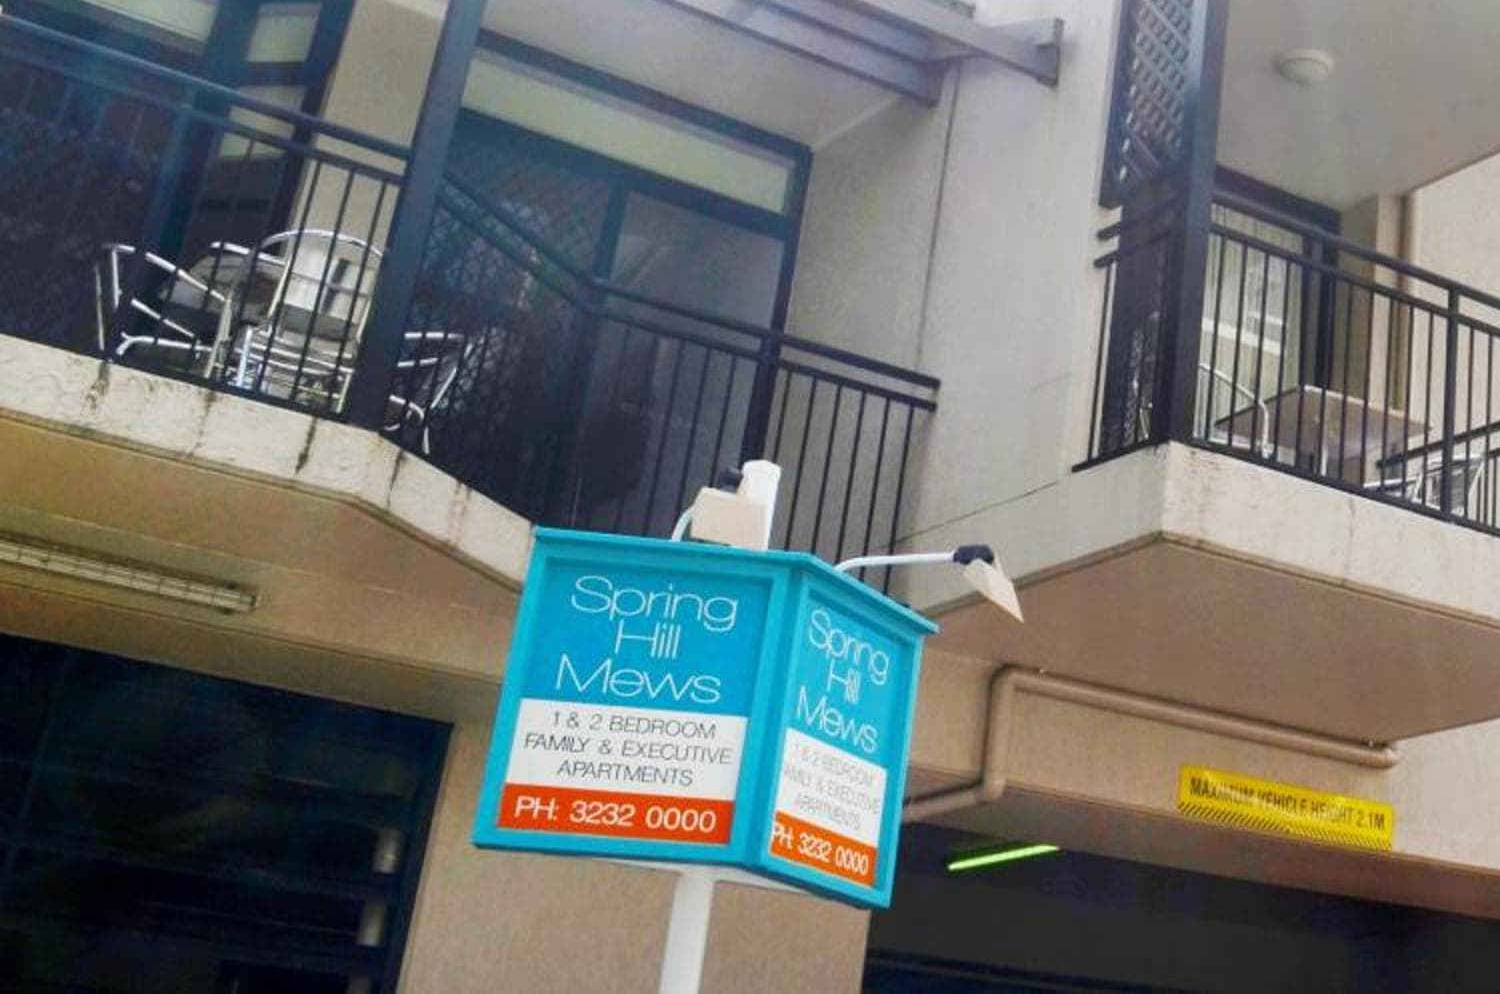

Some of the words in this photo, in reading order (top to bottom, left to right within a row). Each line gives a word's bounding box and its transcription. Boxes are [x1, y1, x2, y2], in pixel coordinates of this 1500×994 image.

[572, 575, 738, 632] Spring
[614, 618, 681, 659] Hill
[809, 609, 889, 685] Spring
[555, 653, 721, 704] Mews
[826, 658, 862, 704] Hill
[552, 710, 561, 727] 1
[566, 712, 580, 730] &
[589, 713, 603, 731] 2
[609, 715, 717, 739] BEDROOM
[796, 686, 878, 753] Mews
[523, 733, 591, 754] FAMILY
[600, 738, 613, 756] &
[621, 739, 735, 765] EXECUTIVE
[556, 759, 694, 787] APARTMENTS
[514, 795, 559, 821] PH:
[569, 800, 637, 827] 3232
[645, 807, 718, 834] 0000
[1257, 788, 1307, 817] VEHICLE
[1357, 807, 1385, 831] 2.1M
[798, 832, 833, 863] 3232
[835, 845, 870, 876] 0000
